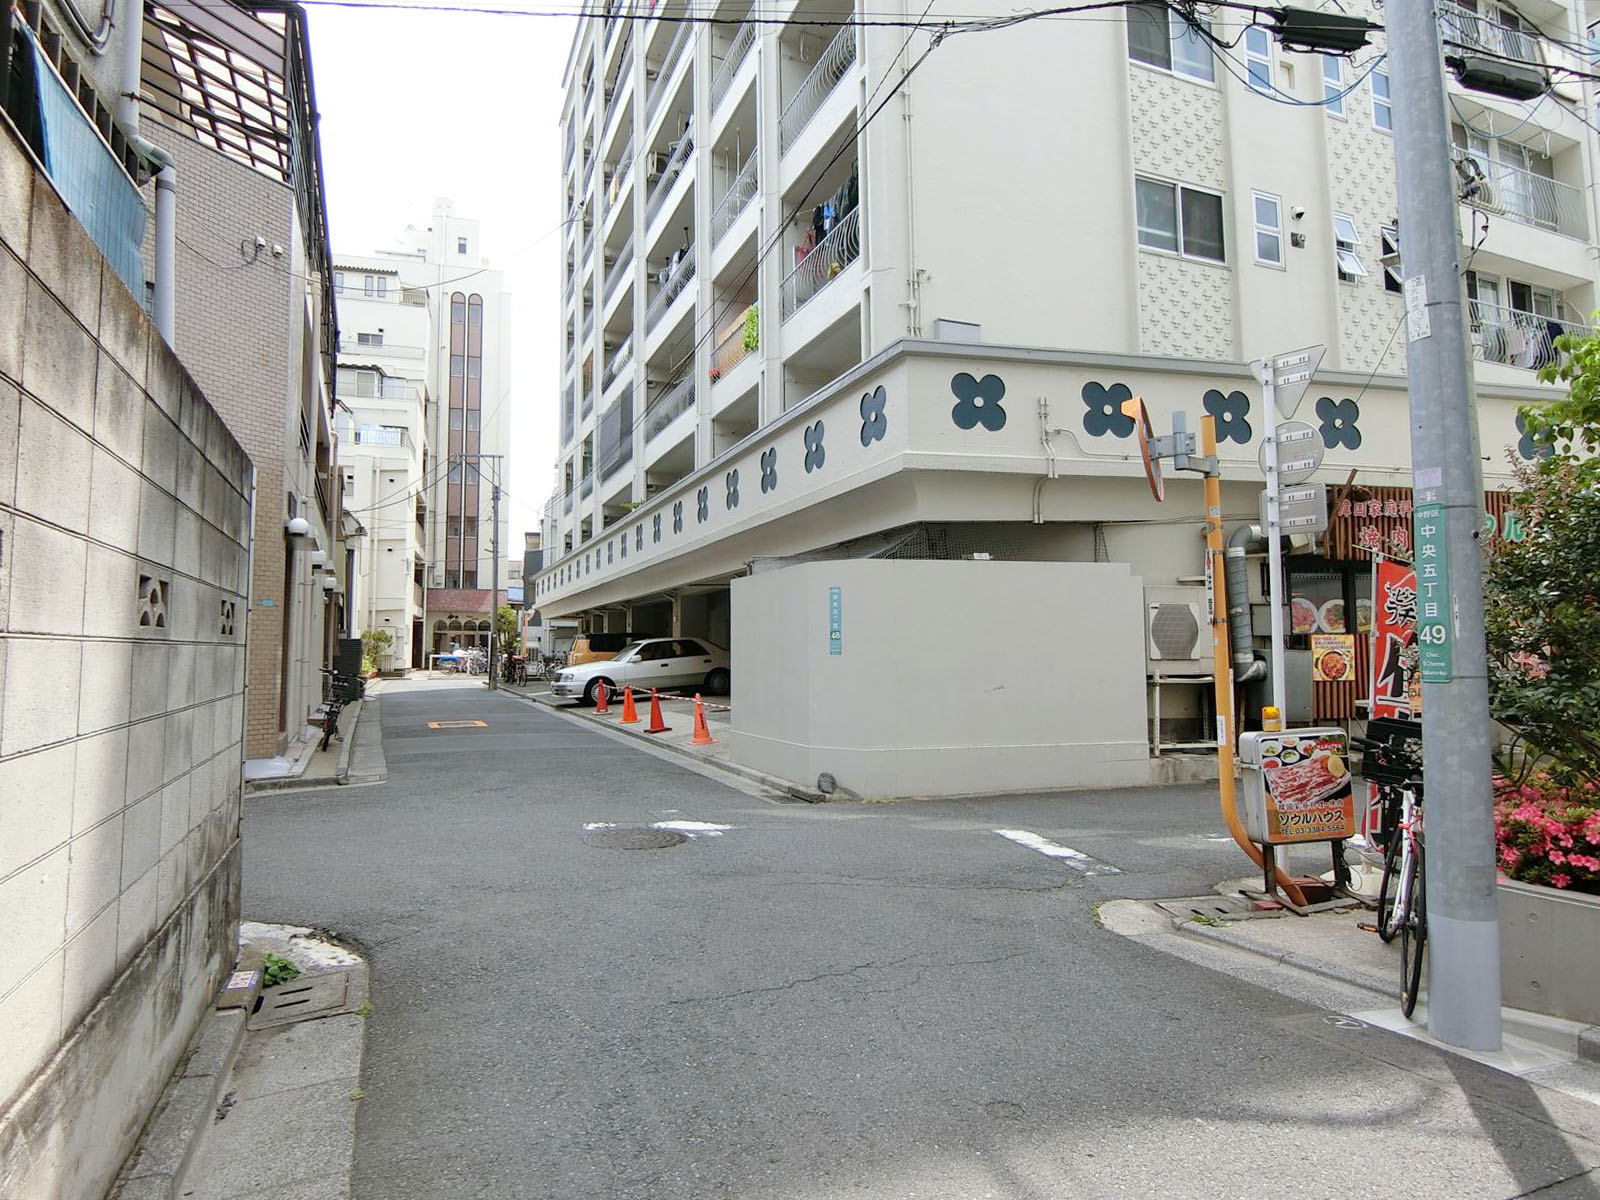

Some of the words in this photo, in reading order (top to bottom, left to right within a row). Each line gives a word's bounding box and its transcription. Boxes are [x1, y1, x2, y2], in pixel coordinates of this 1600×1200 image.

[1420, 523, 1438, 617] 中央五丁目
[1419, 624, 1446, 645] 49
[1280, 810, 1344, 826] ソウルハウス
